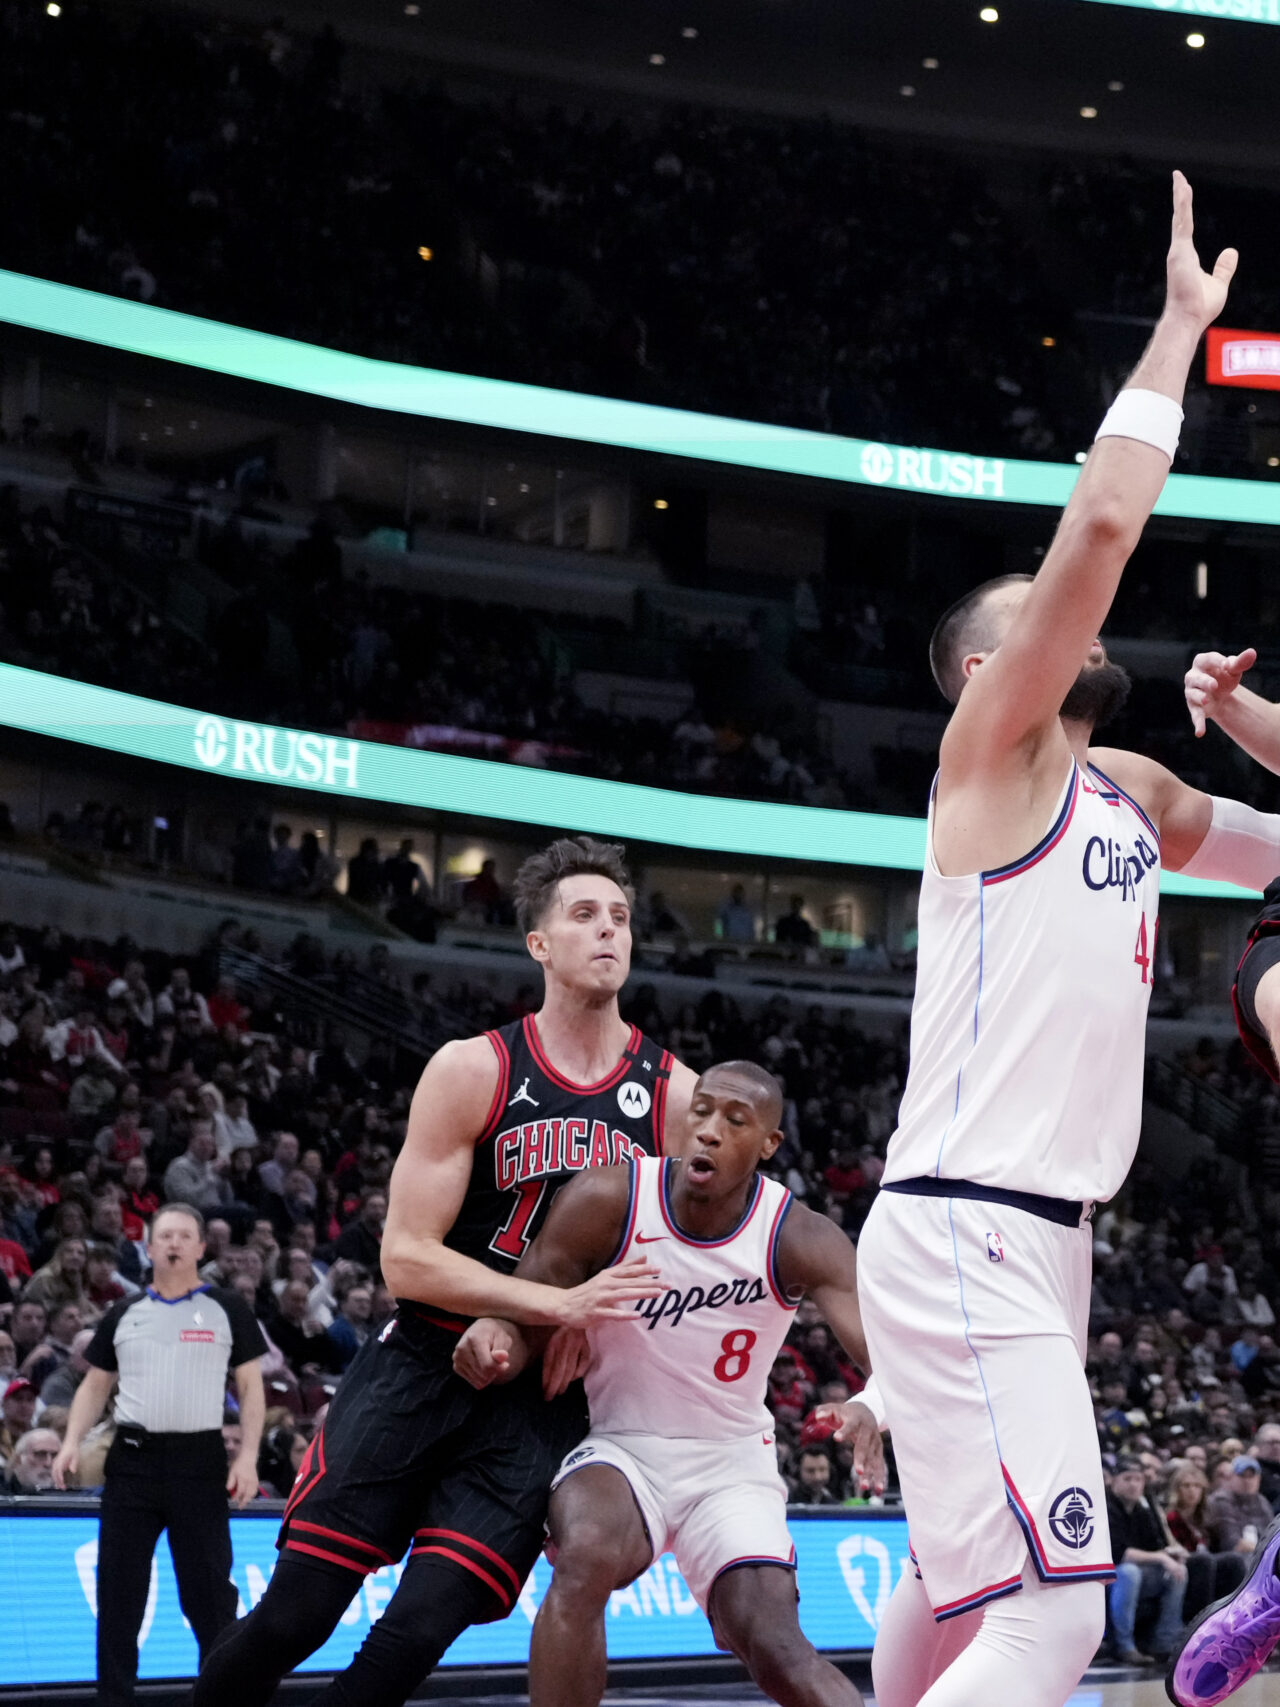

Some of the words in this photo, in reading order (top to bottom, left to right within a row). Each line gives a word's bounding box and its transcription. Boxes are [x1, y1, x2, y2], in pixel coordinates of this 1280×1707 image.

[898, 449, 1006, 496] RUSH
[233, 721, 360, 789] RUSH
[1134, 911, 1160, 987] 4
[488, 1179, 557, 1261] 1
[713, 1329, 757, 1383] 8
